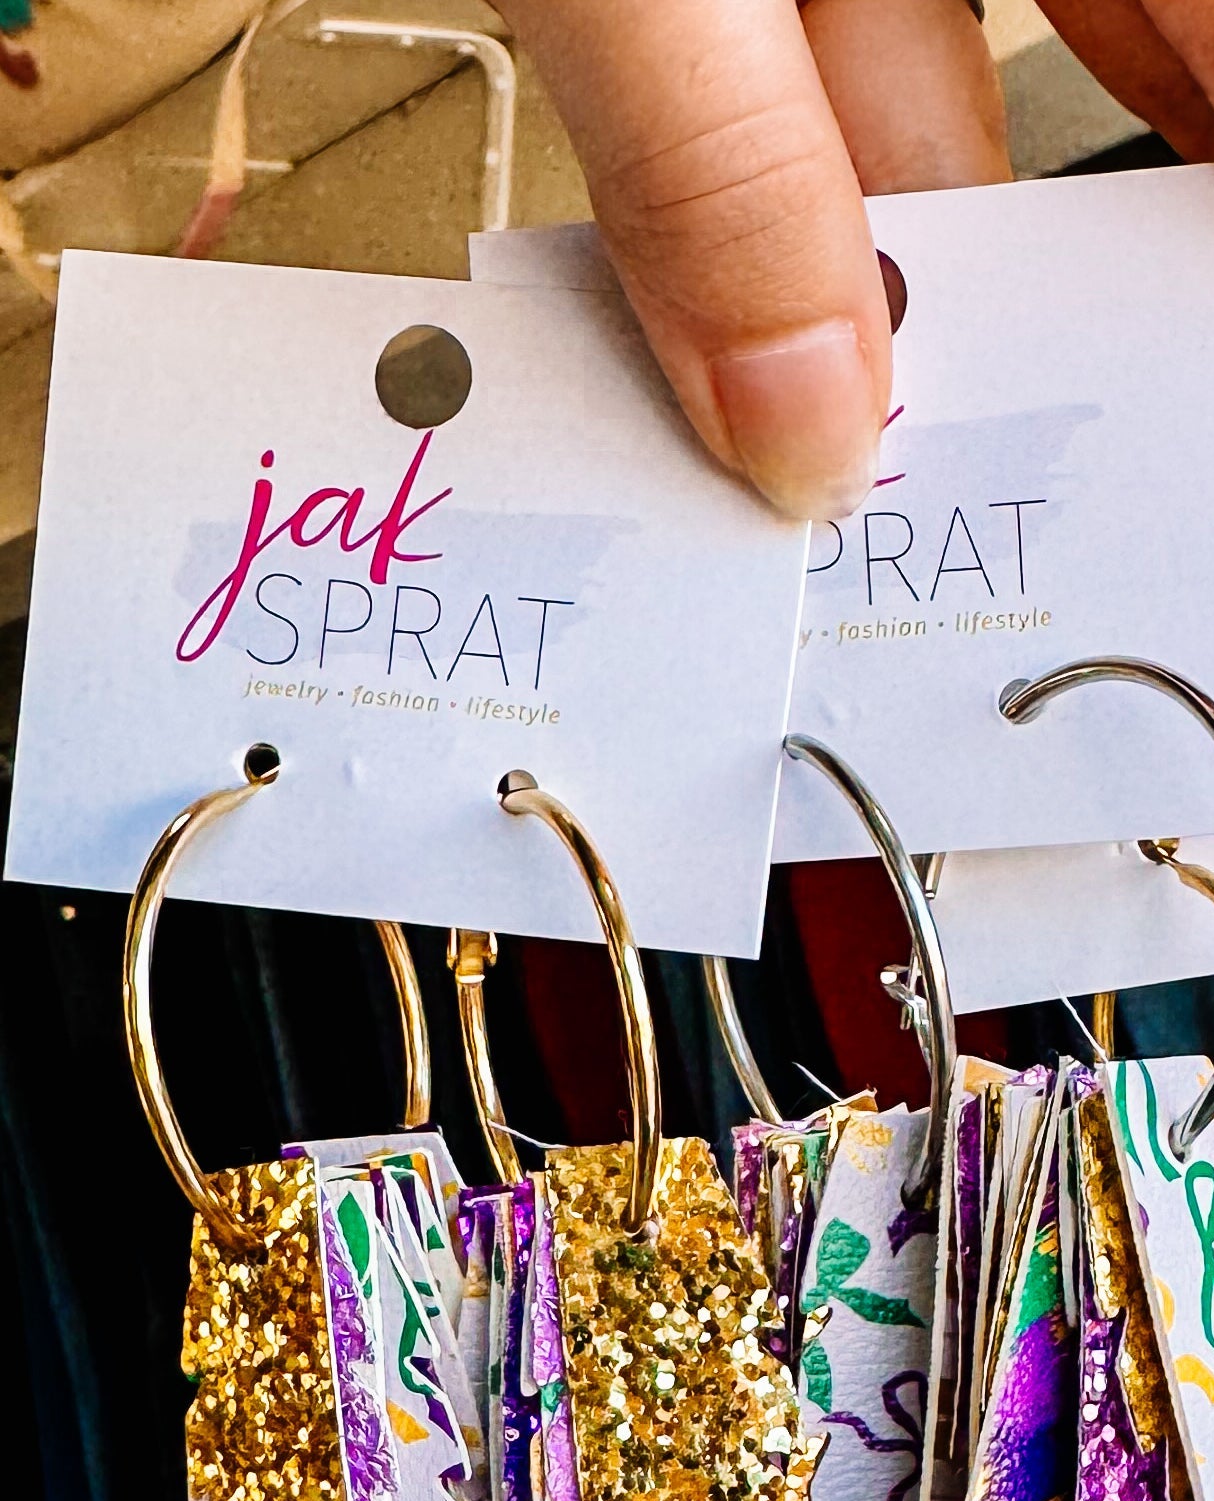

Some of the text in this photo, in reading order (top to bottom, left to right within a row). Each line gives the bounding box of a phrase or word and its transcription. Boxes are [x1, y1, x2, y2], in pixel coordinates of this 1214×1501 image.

[176, 430, 453, 662] jak
[246, 573, 575, 690] SPRAT
[838, 616, 926, 646] fashion
[955, 607, 1051, 635] lifestyle
[243, 674, 561, 726] jewelry fashion lifestyle
